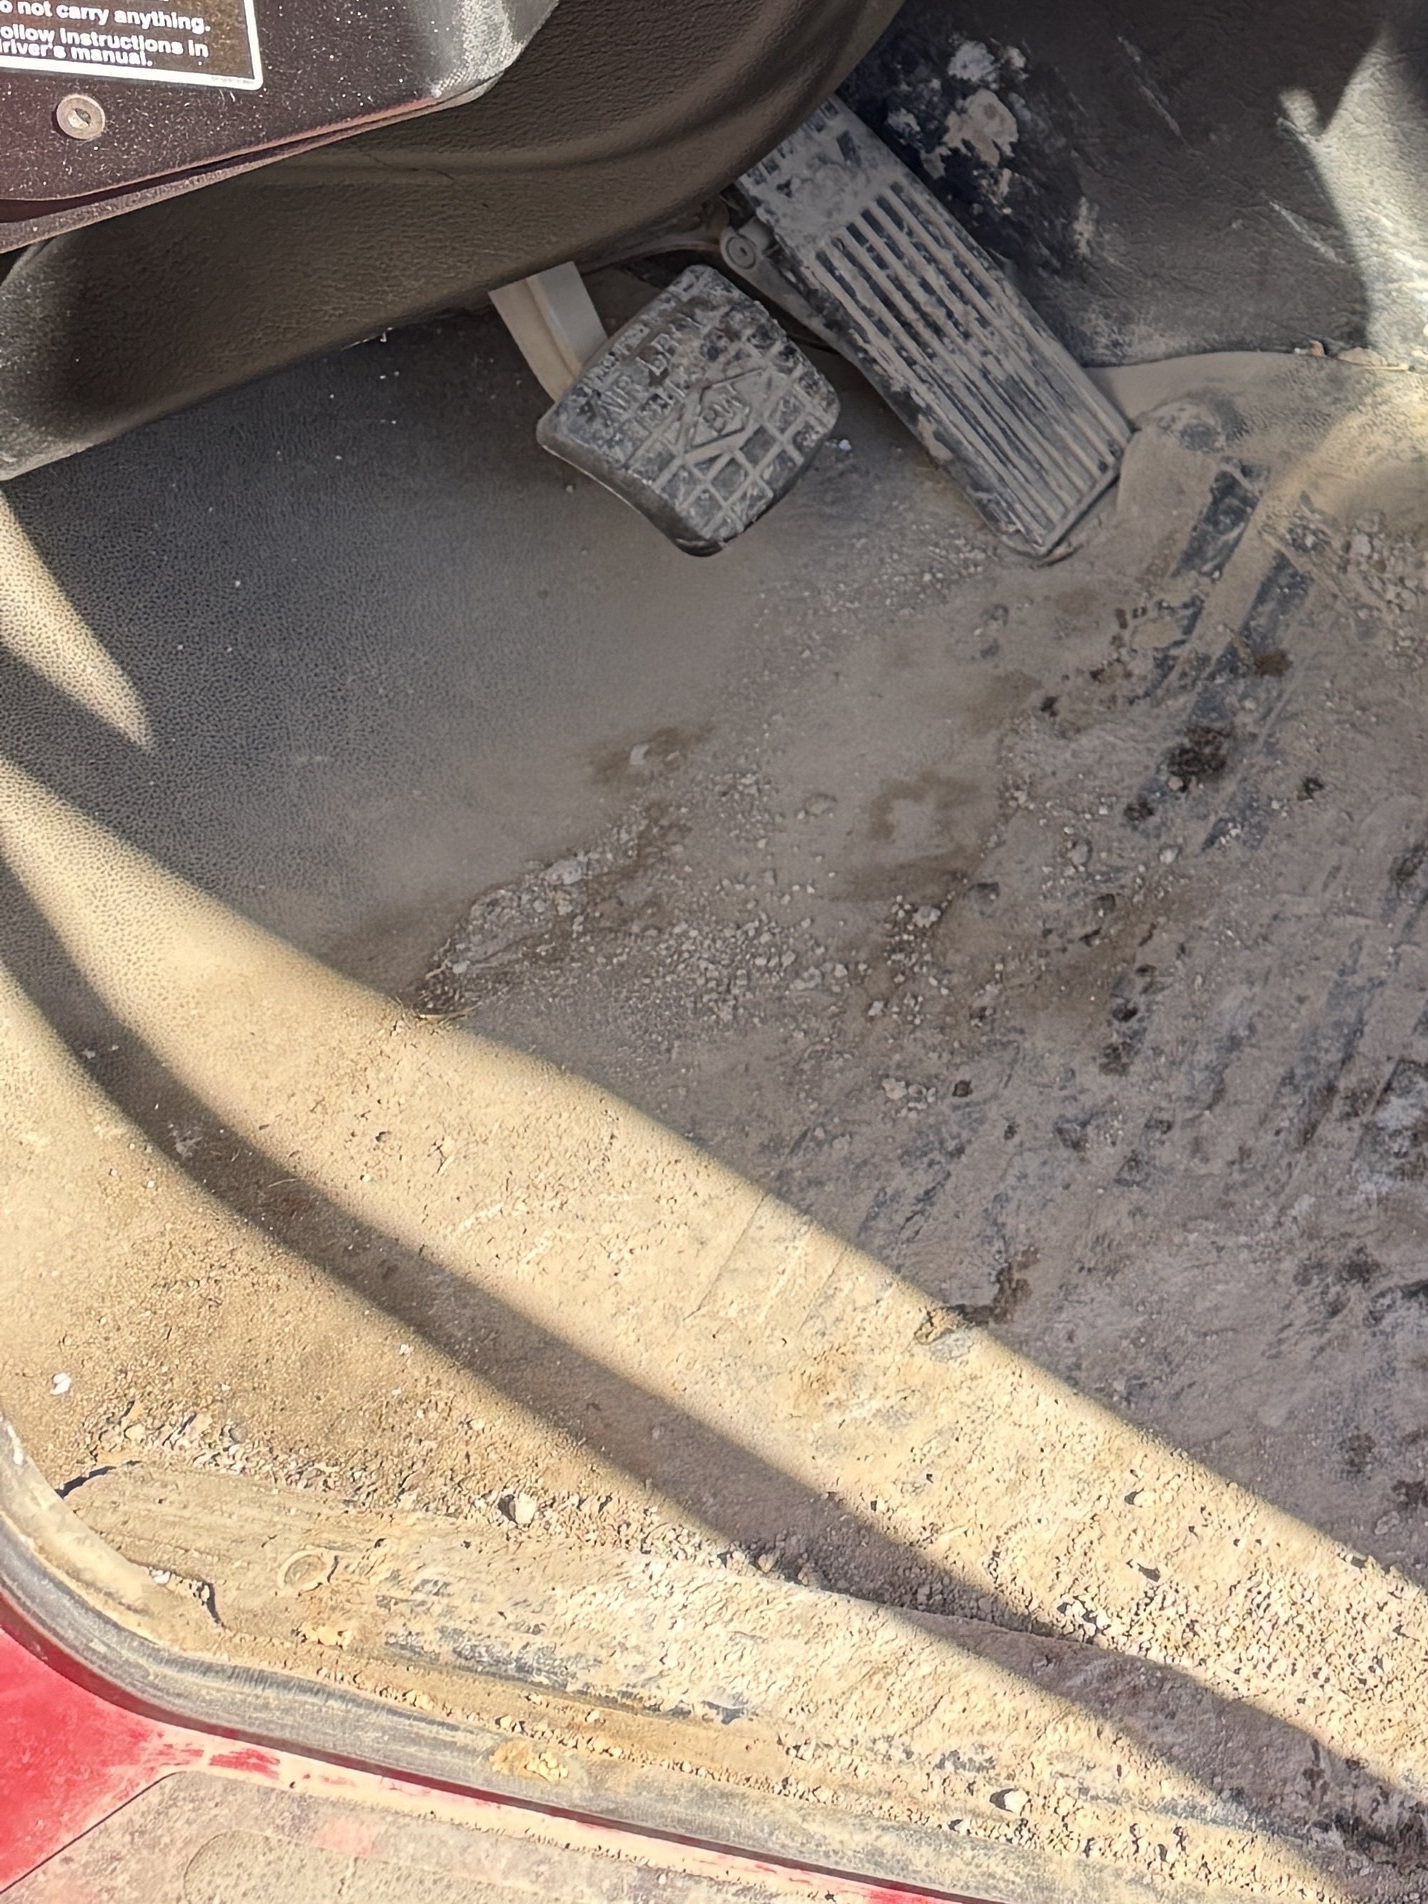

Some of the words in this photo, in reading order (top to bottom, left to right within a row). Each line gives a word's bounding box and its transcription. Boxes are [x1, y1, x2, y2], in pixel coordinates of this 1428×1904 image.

[17, 0, 52, 17] not
[56, 4, 110, 26] carry
[114, 9, 211, 35] anything.
[60, 27, 184, 55] instructions
[188, 39, 209, 58] in
[71, 45, 153, 67] manual.
